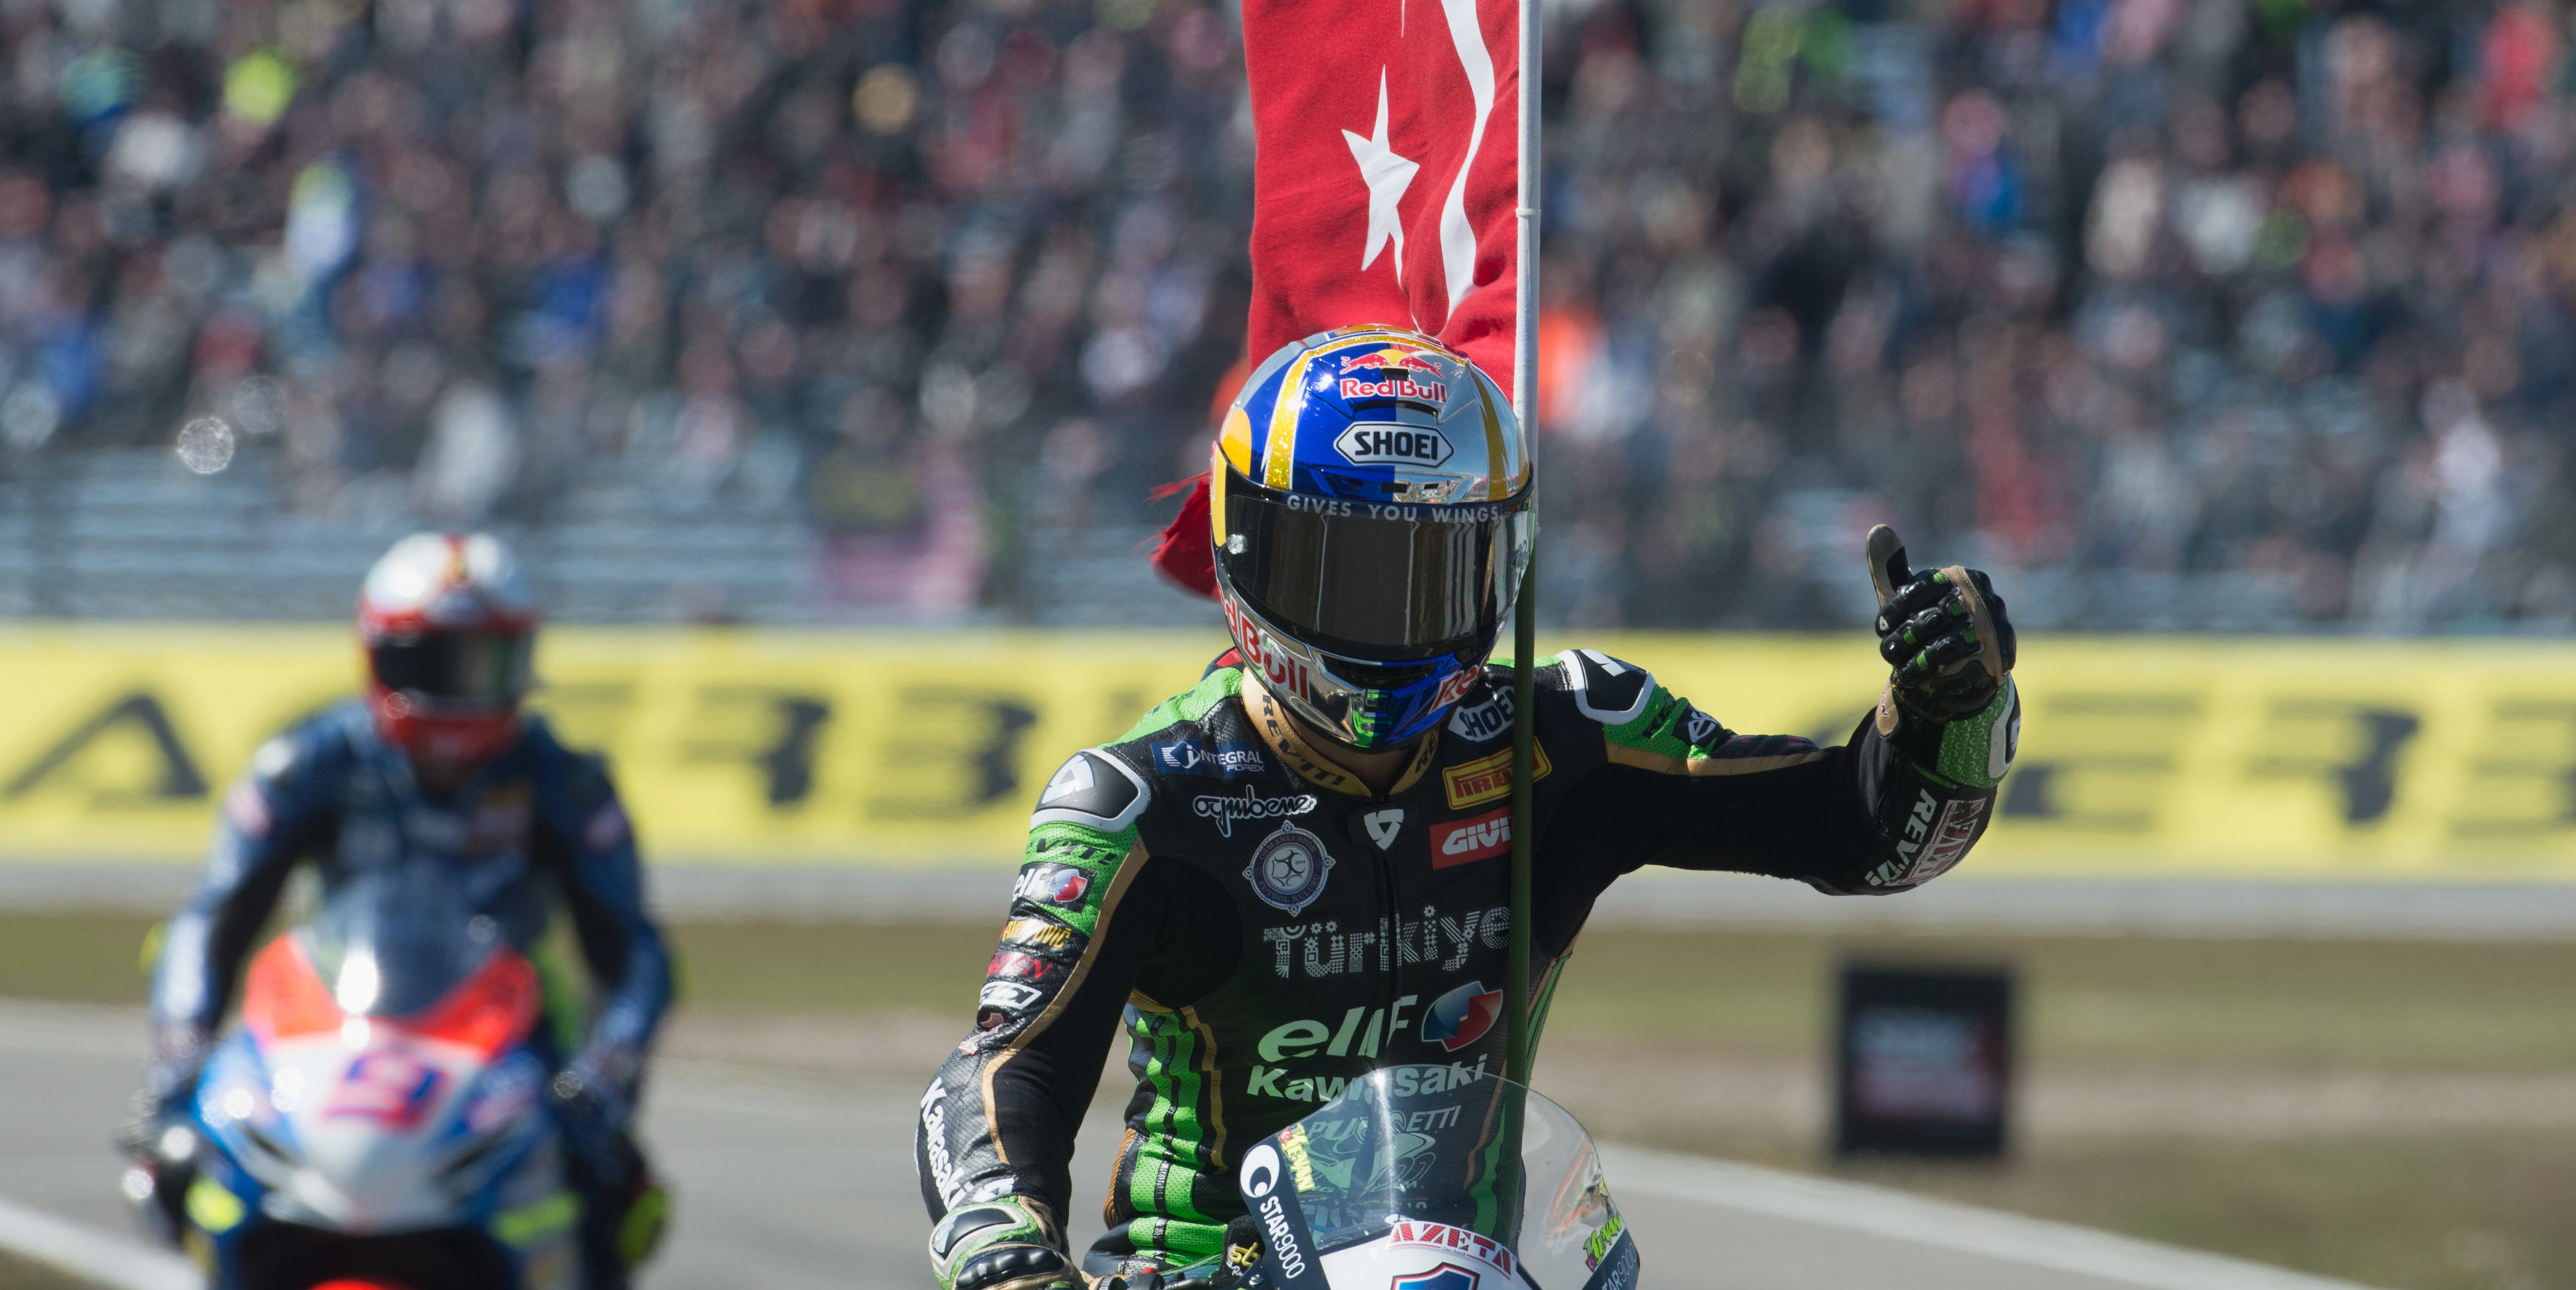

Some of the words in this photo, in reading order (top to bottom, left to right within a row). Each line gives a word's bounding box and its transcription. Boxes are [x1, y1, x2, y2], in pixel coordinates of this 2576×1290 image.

[1340, 378, 1395, 398] Red
[1400, 380, 1447, 403] Bull
[1354, 431, 1438, 460] SHOEI
[1287, 494, 1352, 517] GIVES
[1367, 504, 1417, 521] YOU
[1432, 506, 1499, 523] WINGS
[1240, 611, 1310, 702] Bull
[1226, 764, 1266, 772] FOREX
[1442, 815, 1511, 855] GIVI
[1262, 904, 1510, 979] Türkiye
[921, 1076, 974, 1213] Kawasaki
[1259, 1195, 1306, 1279] STAR9000
[1390, 1222, 1512, 1276] AZETA
